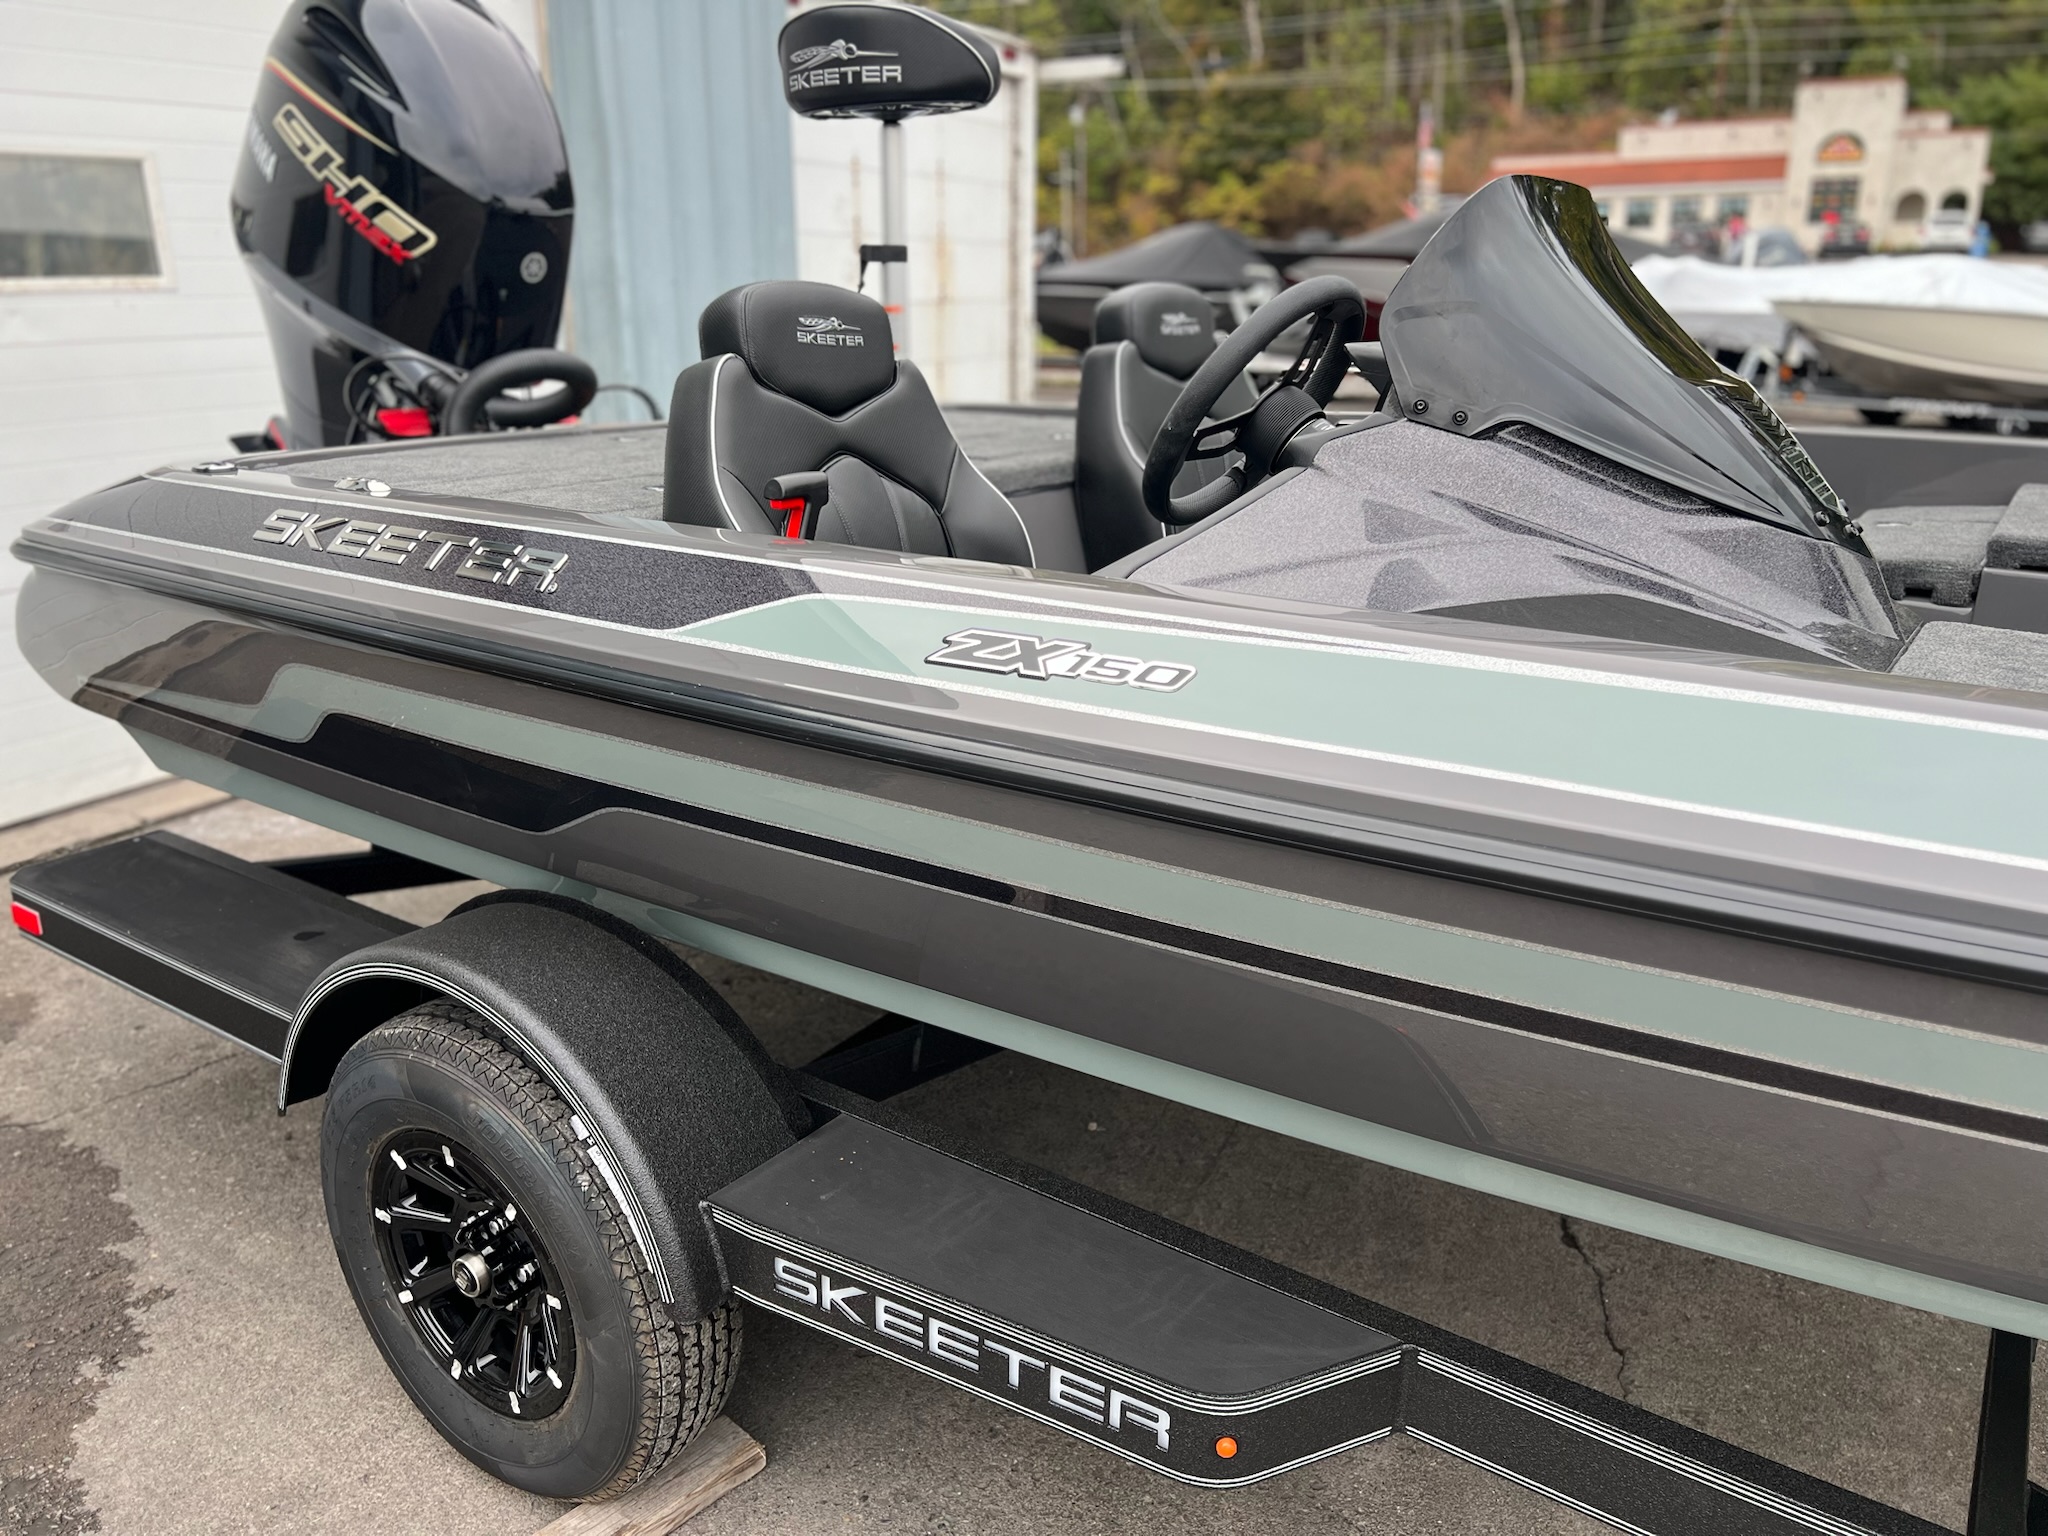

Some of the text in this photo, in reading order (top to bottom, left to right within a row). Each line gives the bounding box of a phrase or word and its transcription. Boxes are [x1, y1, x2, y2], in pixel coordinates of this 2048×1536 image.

[789, 66, 902, 92] SKEETER
[272, 102, 438, 259] SHO
[797, 331, 864, 347] SKEETER
[252, 508, 570, 594] SKEETER
[924, 627, 1198, 694] ZX150
[773, 1256, 1171, 1453] SKEETER
